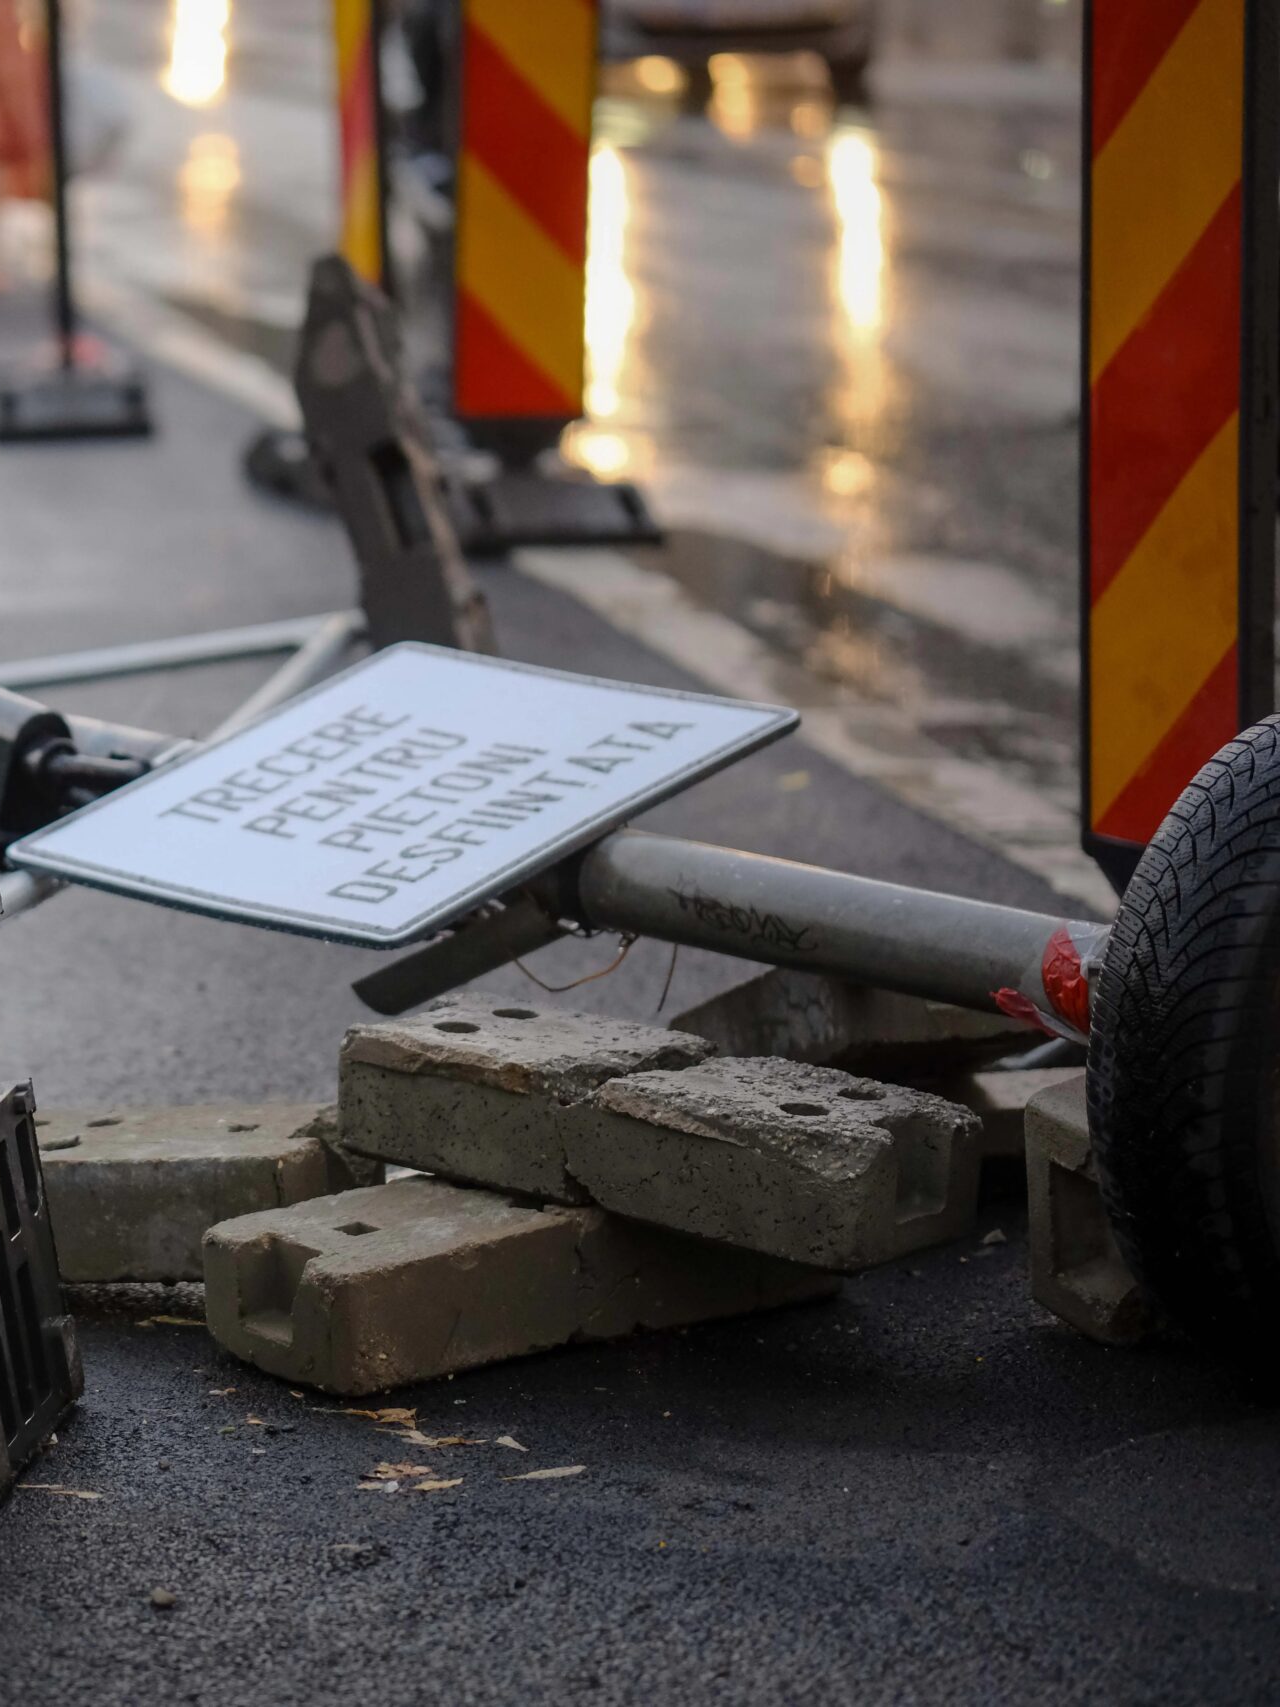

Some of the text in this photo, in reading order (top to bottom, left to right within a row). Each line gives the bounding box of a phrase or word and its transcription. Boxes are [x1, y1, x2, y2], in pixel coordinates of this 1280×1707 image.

[157, 704, 412, 823] TRECERE
[240, 727, 468, 839] PENTRU
[317, 742, 549, 853] PIETONI
